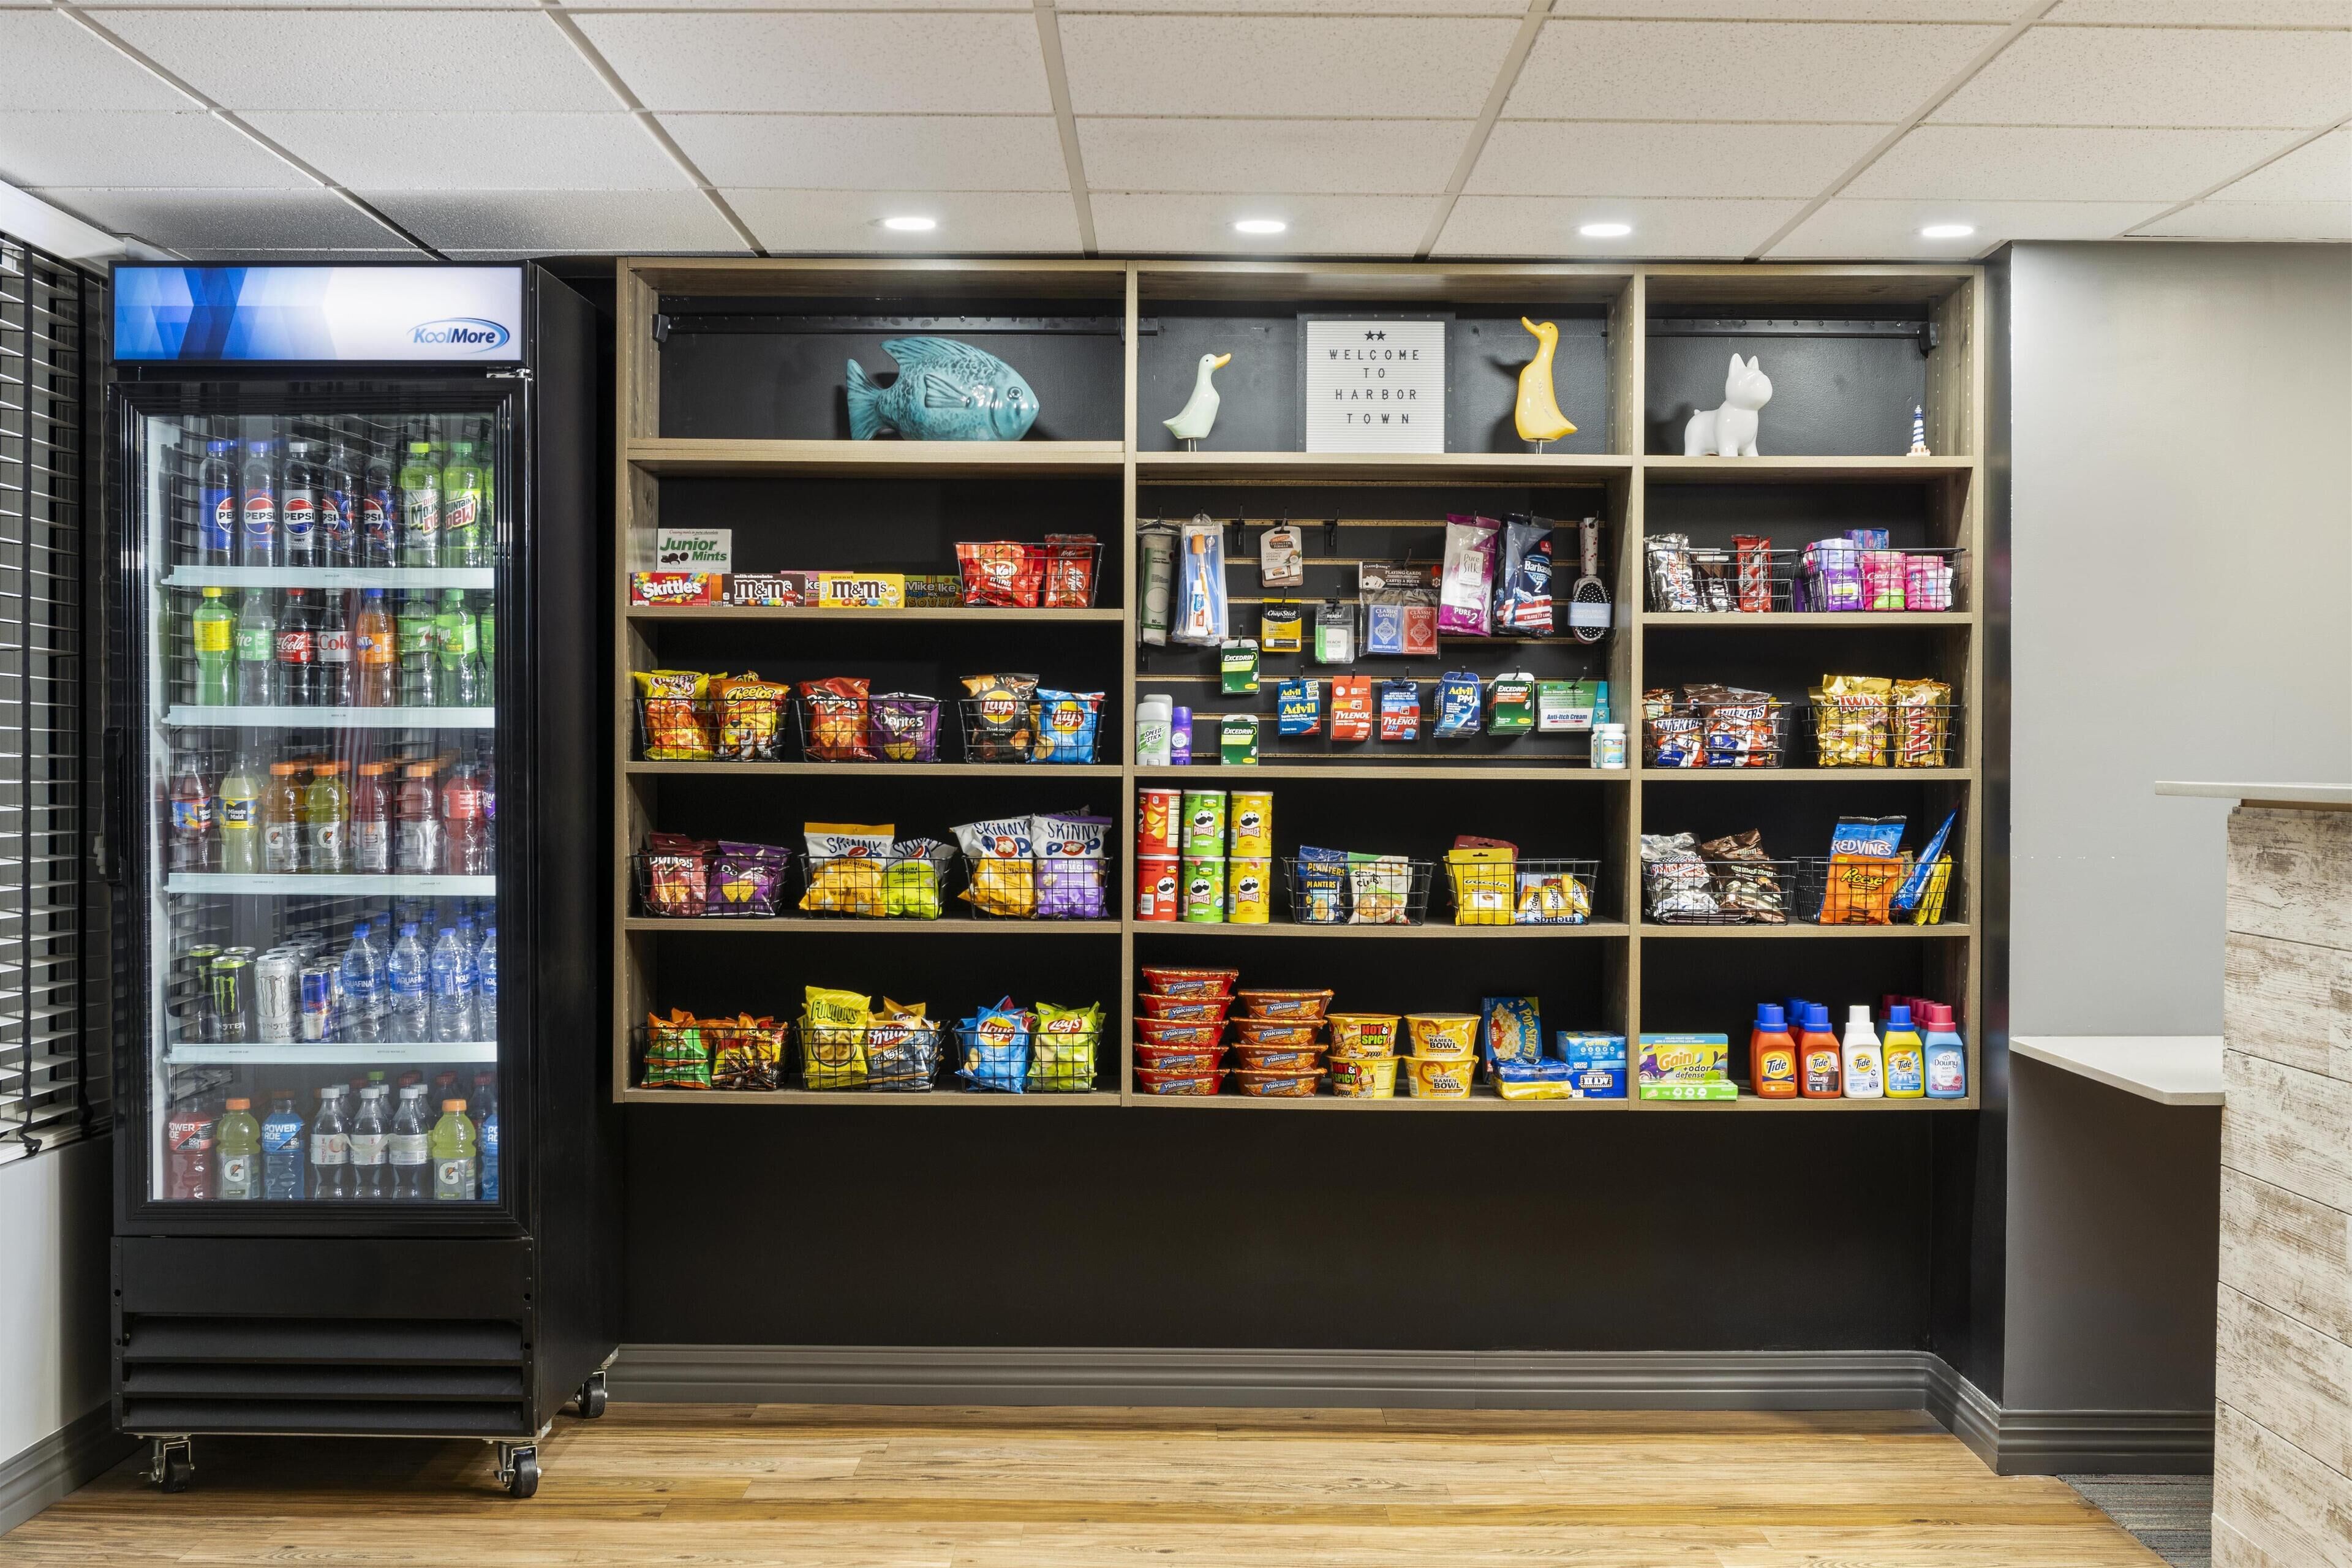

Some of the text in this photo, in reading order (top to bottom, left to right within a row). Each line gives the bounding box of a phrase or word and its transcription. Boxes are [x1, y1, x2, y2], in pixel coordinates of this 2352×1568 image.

[412, 327, 495, 344] KoolMore
[1330, 350, 1419, 360] WELCOME
[1363, 368, 1385, 378] TO
[1336, 390, 1416, 399] HARBOR
[1348, 414, 1408, 424] TOWN
[660, 538, 717, 551] Junior
[692, 551, 727, 561] Mints
[1464, 554, 1480, 562] Pure
[1464, 563, 1480, 574] Silk
[1868, 572, 1897, 581] Carefree
[643, 579, 702, 598] Skittles
[906, 582, 956, 592] Mike Ike
[1534, 581, 1542, 593] 2
[1454, 608, 1477, 624] PURE 2
[726, 686, 775, 705] Cheetos
[1448, 686, 1473, 695] Advil
[1457, 695, 1473, 703] PM
[1836, 694, 1884, 713] TWIX
[1283, 703, 1316, 714] Advil
[1716, 706, 1765, 718] SNICKERS
[880, 713, 924, 728] Doritos
[1054, 710, 1082, 726] Lay's
[1145, 728, 1162, 737] SPEED
[1905, 694, 1931, 761] TWIX
[1147, 734, 1162, 742] STICK
[1194, 826, 1214, 836] PRINGLES
[1240, 827, 1259, 837] PRINGLES
[265, 827, 283, 849] G
[317, 827, 337, 848] G
[982, 835, 1031, 858] POP
[1046, 838, 1101, 856] POP
[1831, 840, 1891, 856] RED VINES
[1308, 863, 1344, 876] PLANTERS
[1190, 894, 1210, 904] PRINGLES
[1238, 892, 1259, 902] PRINGLES
[1528, 891, 1539, 914] Trident
[398, 975, 426, 985] AQUAFINA
[1171, 1006, 1202, 1015] Yakisoba
[981, 1022, 1015, 1041] Lay's
[1049, 1019, 1081, 1033] Lay's
[1362, 1024, 1382, 1035] HOT
[869, 1023, 910, 1048] Fritos
[1164, 1029, 1194, 1038] Yakisoba
[1362, 1035, 1387, 1045] SPICY
[1163, 1056, 1193, 1065] Yakisoba
[1267, 1054, 1296, 1063] Yakisoba
[1659, 1052, 1692, 1070] Gain
[1813, 1058, 1828, 1068] Tide
[1855, 1057, 1871, 1069] Tide
[1934, 1059, 1958, 1068] Downy
[1333, 1062, 1348, 1074] HOT
[1766, 1060, 1787, 1074] Tide
[1898, 1060, 1912, 1070] Tide
[1334, 1074, 1355, 1084] SPICY
[265, 1124, 296, 1133] POWER
[224, 1159, 244, 1182] G
[439, 1162, 459, 1185] G
